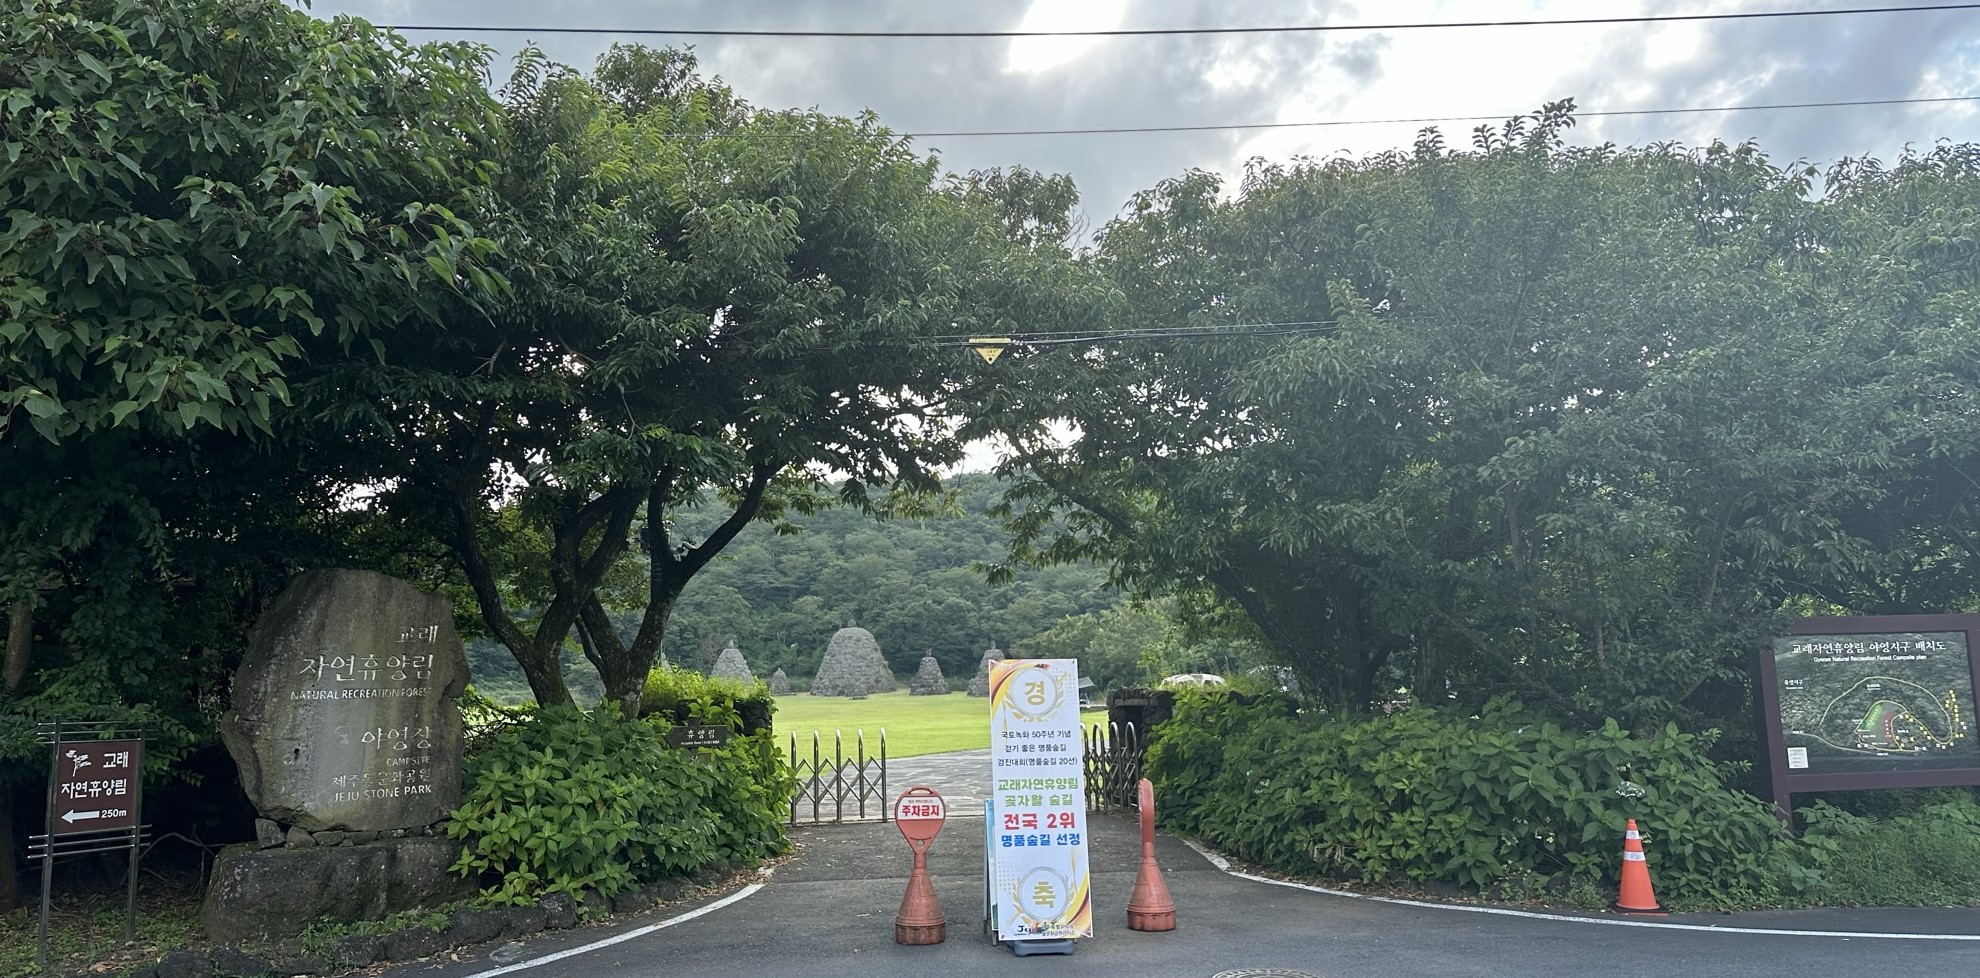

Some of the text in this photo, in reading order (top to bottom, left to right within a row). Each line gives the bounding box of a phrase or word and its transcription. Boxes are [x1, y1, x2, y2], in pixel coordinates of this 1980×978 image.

[397, 625, 438, 644] 교래
[1792, 640, 1946, 655] 교래자연휴양림 야영지구 배치도
[300, 654, 434, 683] 자연휴양림
[290, 687, 432, 700] NATURAL RECREATION FOREST
[1024, 681, 1045, 705] 경
[362, 726, 434, 750] 야영장
[687, 730, 714, 739] 휴양림
[1022, 744, 1036, 752] 좋은
[1038, 744, 1066, 752] 명품숲길
[103, 751, 128, 768] 교래
[386, 756, 430, 766] CAMPSITE
[62, 779, 126, 799] 자연휴양림
[998, 778, 1078, 790] 교래자연휴양림
[334, 785, 432, 802] JEJU STONE PARK
[1005, 794, 1072, 807] 곶자왈 숲길
[101, 809, 126, 818] 250m
[902, 805, 939, 816] 주차금지
[1004, 812, 1075, 830] 전국 2위
[1002, 833, 1080, 847] 명품숲길 선정
[1032, 882, 1056, 908] 축
